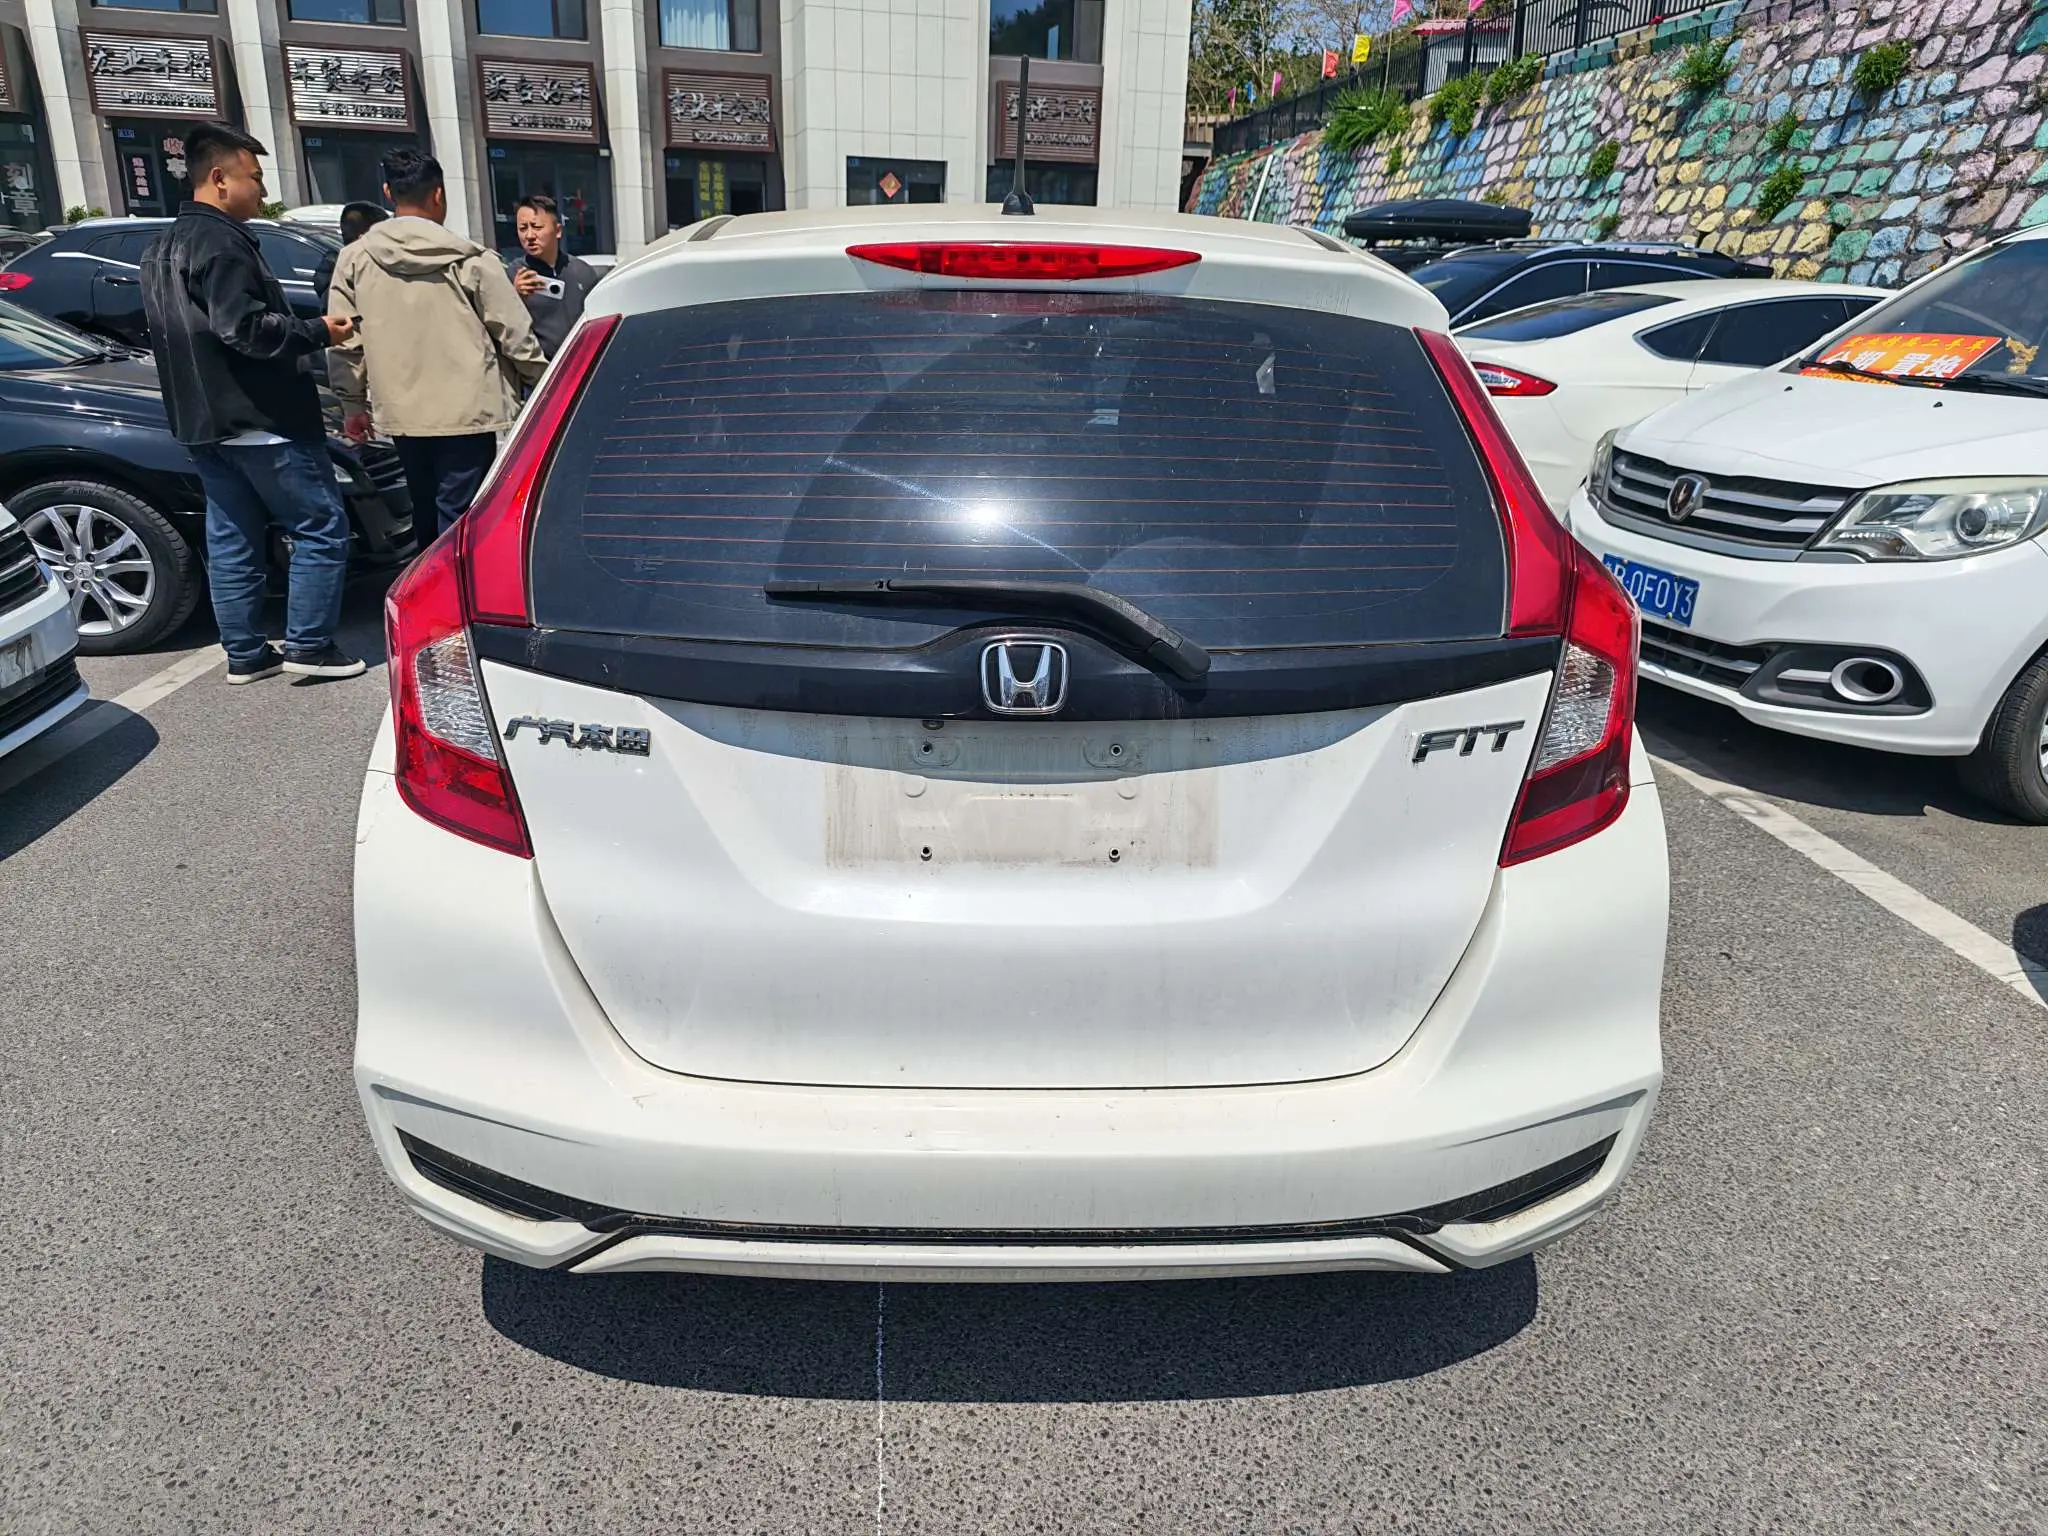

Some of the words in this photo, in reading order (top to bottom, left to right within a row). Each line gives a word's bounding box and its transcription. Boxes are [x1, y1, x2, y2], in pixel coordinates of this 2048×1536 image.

[503, 715, 651, 757] 广汽本田
[1411, 719, 1526, 763] FIT
